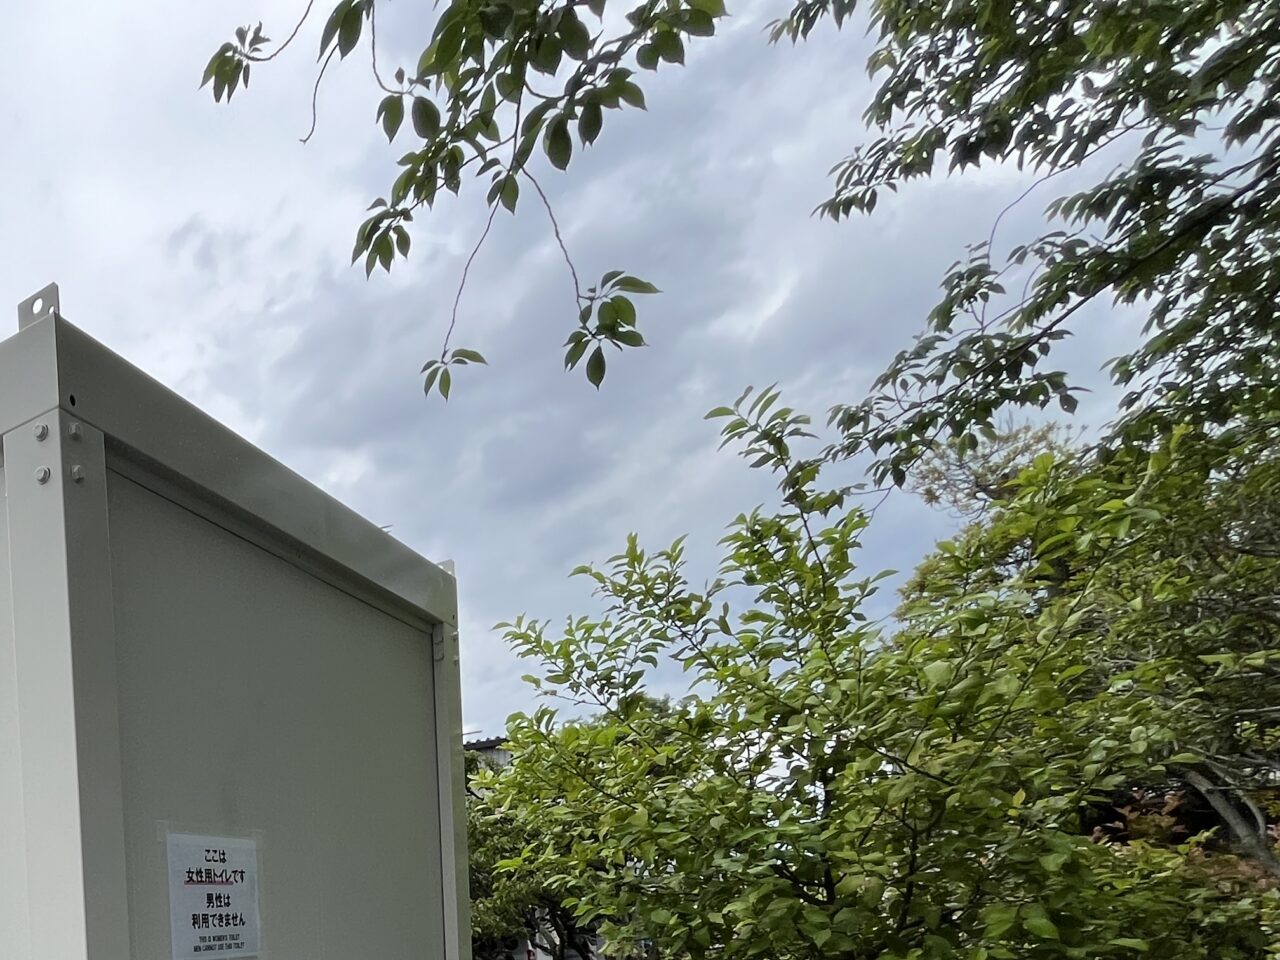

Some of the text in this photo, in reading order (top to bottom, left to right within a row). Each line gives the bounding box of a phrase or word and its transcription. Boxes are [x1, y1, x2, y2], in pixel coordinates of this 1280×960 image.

[205, 849, 226, 863] ここは
[185, 867, 246, 884] 女性用トイレです
[206, 892, 231, 908] 男性は
[191, 912, 246, 929] 利用できません
